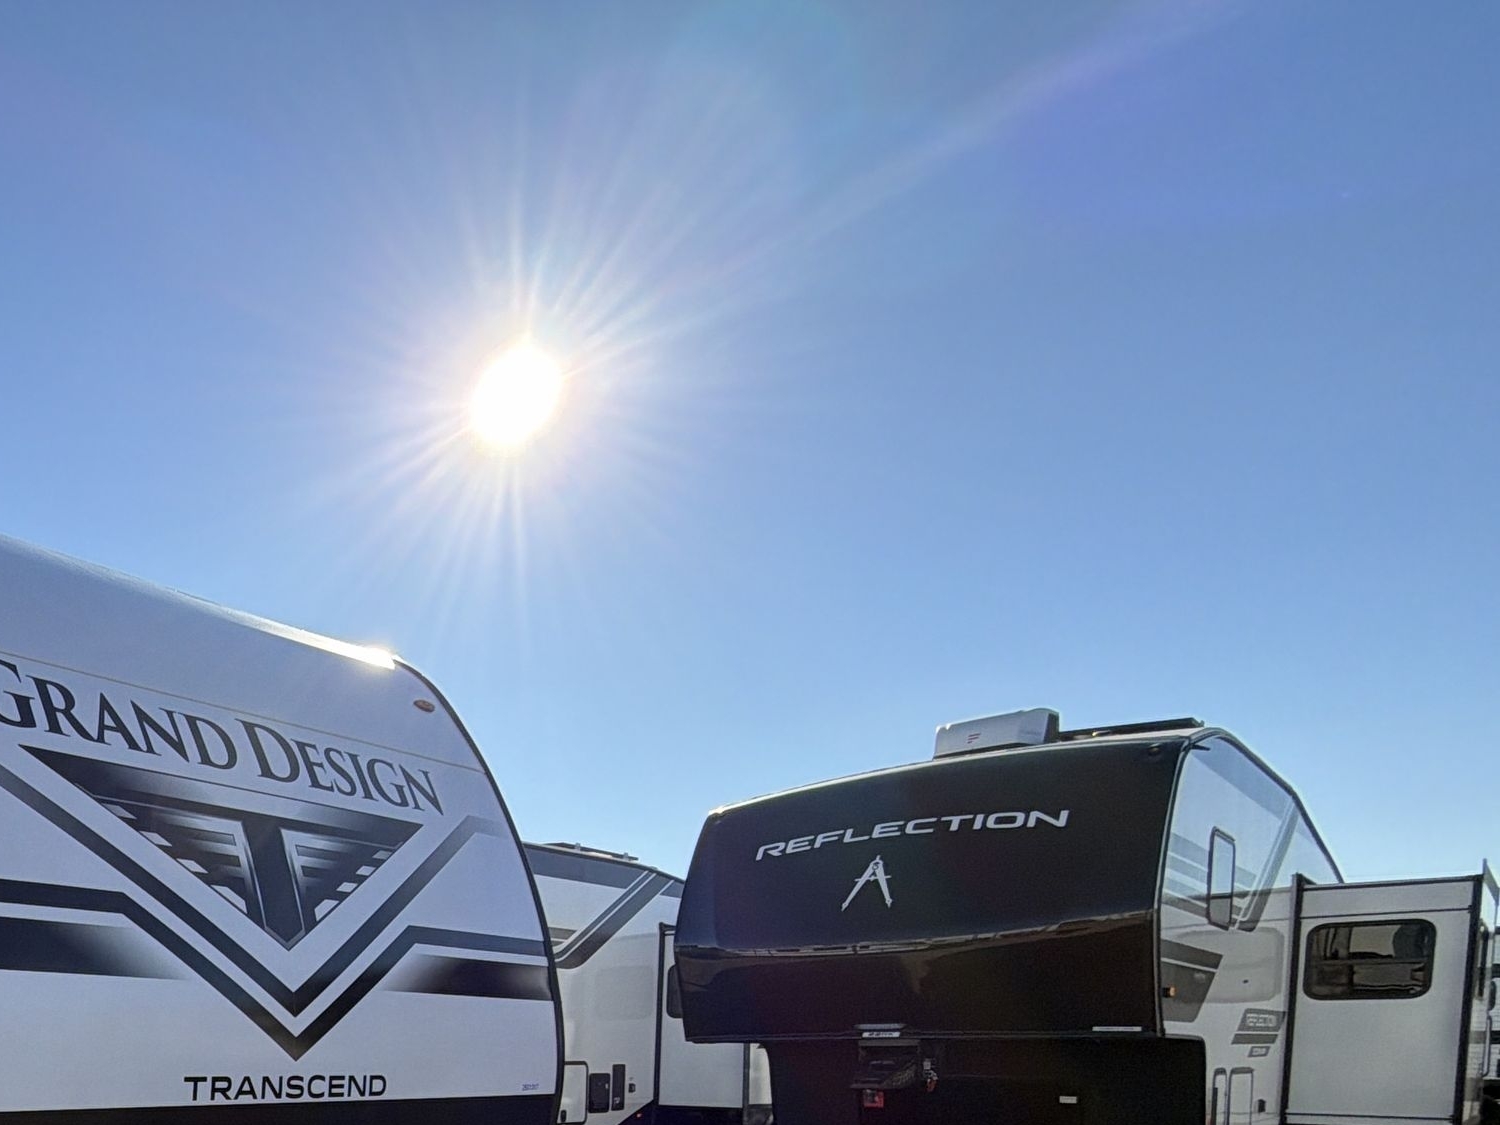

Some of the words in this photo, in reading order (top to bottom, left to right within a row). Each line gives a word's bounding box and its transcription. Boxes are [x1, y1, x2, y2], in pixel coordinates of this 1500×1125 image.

[235, 717, 445, 817] DESIGN
[755, 809, 1070, 861] REFLECTION
[183, 1074, 388, 1102] TRANSCEND
